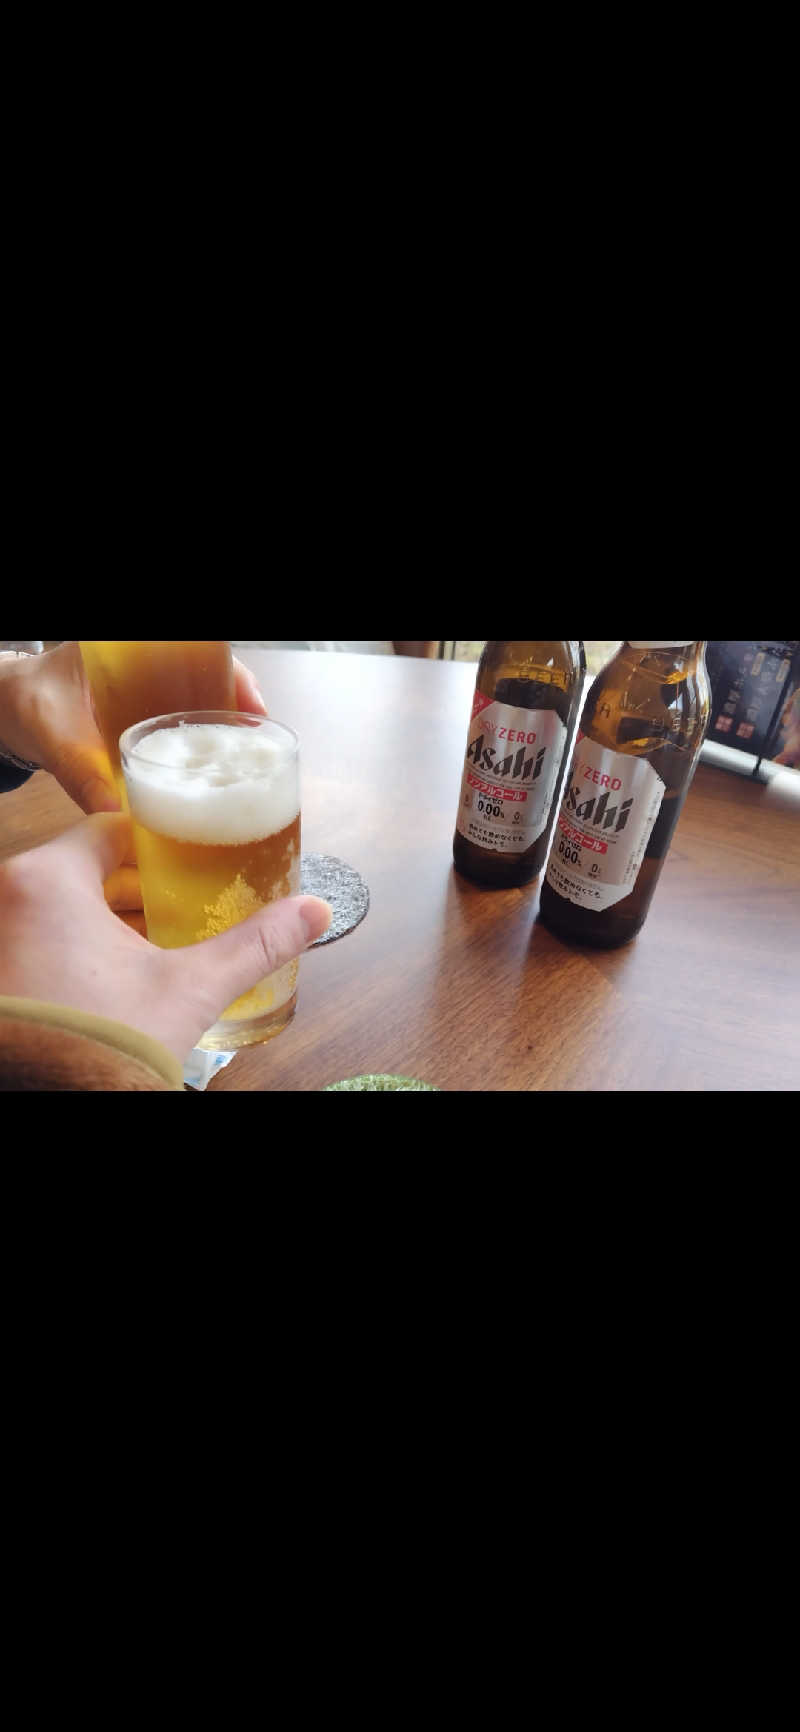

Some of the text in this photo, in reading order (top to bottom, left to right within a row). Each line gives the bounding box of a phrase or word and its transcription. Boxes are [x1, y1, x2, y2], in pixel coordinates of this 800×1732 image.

[498, 727, 537, 745] ZERO
[466, 734, 547, 781] Asahi
[583, 766, 622, 791] ZERO
